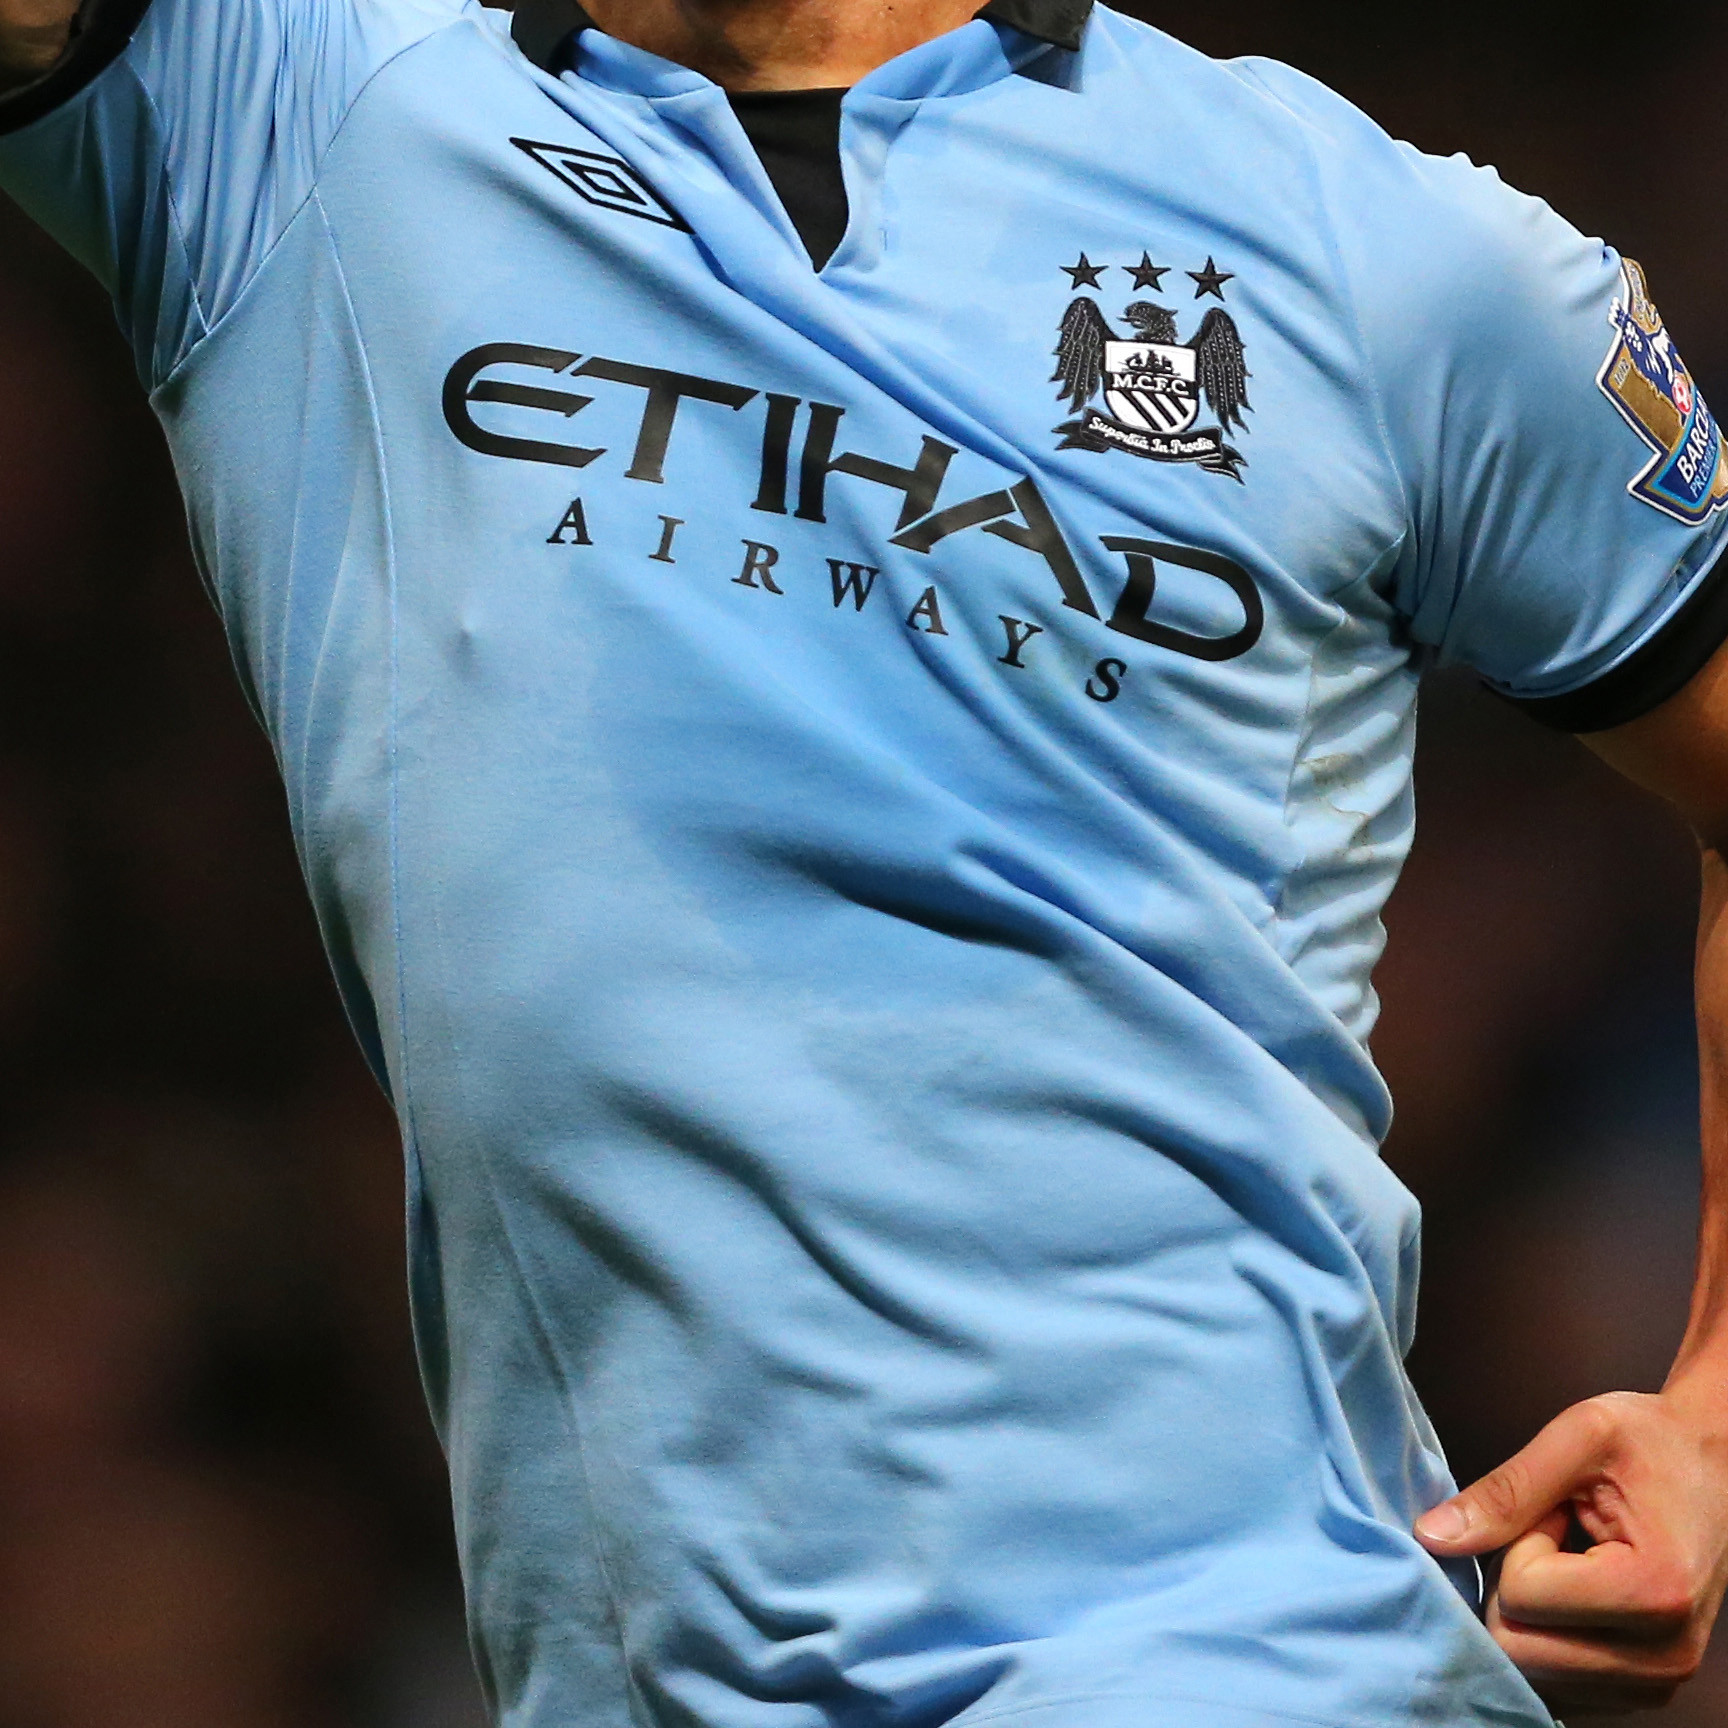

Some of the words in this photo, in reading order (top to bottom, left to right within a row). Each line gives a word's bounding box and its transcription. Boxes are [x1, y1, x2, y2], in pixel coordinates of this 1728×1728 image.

[442, 342, 1264, 661] ETIHAD
[1150, 438, 1169, 453] In
[545, 497, 1128, 703] AIRWAYS
